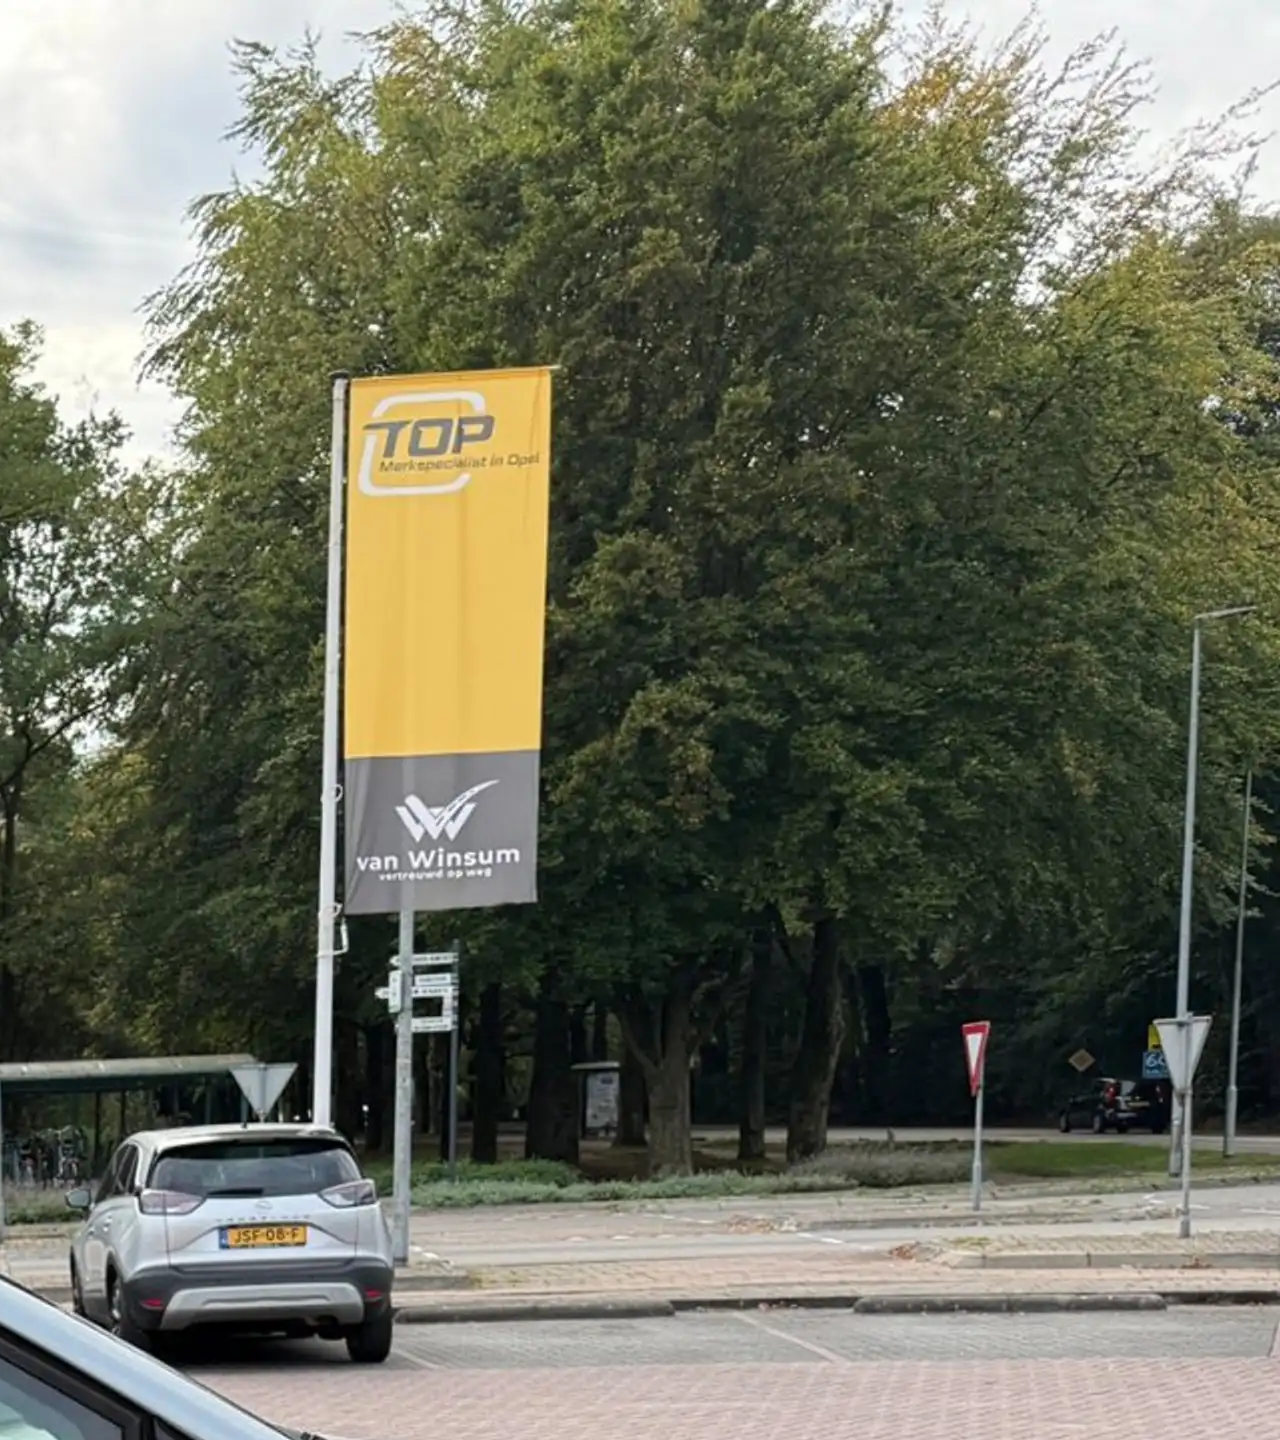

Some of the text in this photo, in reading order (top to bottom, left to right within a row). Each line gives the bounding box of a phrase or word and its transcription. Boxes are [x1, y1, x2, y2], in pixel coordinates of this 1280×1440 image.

[362, 415, 495, 459] TOP
[379, 453, 540, 473] Merkspecialist in Opel
[356, 847, 521, 872] van Winsum
